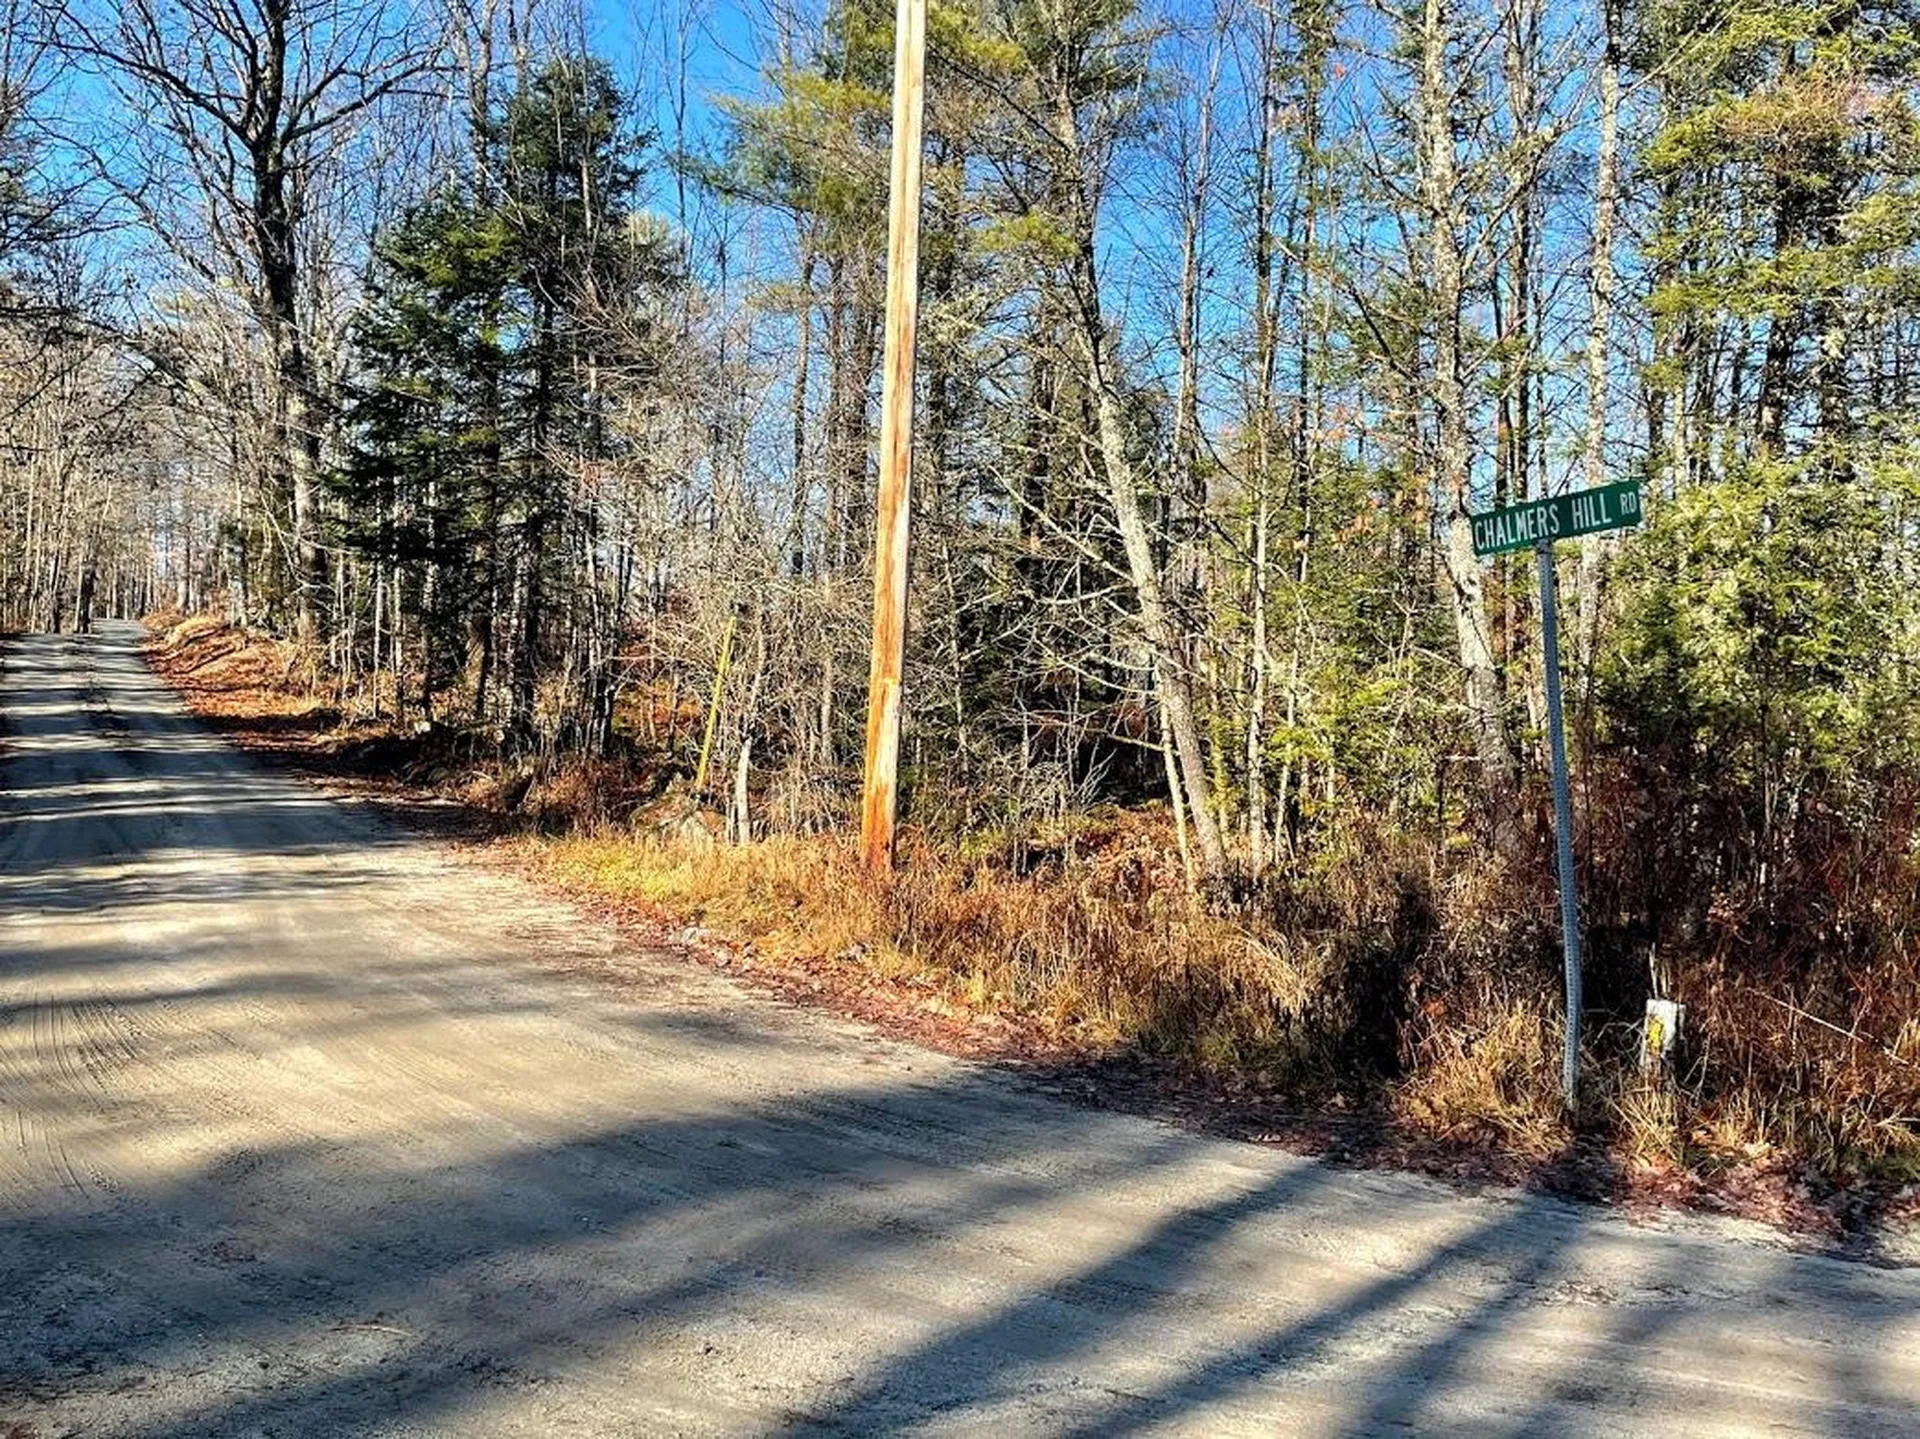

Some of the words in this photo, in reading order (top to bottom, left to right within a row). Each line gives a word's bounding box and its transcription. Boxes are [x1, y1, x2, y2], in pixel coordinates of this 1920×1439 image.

[1474, 504, 1560, 550] CHALMERS
[1571, 493, 1612, 530] HILL
[1620, 491, 1637, 514] RD
